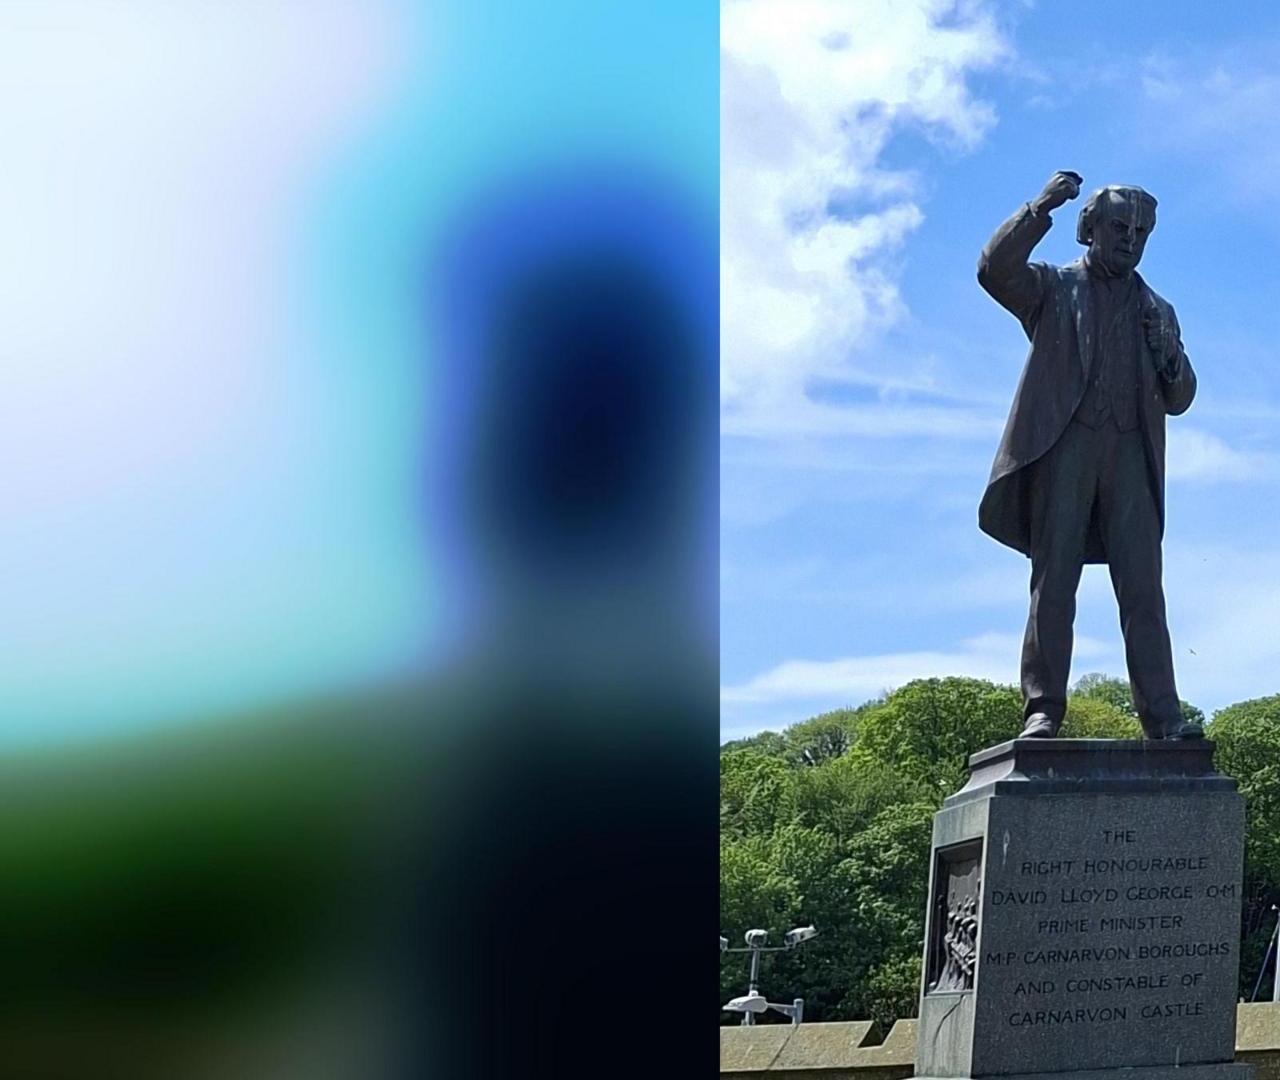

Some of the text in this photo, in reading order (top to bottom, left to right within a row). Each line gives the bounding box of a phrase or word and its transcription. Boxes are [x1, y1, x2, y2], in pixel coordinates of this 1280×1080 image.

[1103, 830, 1137, 844] THE
[1021, 856, 1209, 876] RIGHT HONOURABLE
[991, 889, 1048, 906] DAVID
[1060, 887, 1119, 904] LLOYD
[1125, 885, 1194, 901] GEORGE
[1038, 914, 1184, 934] PRIME MINISTER
[1023, 946, 1131, 965] CARNARVON
[1138, 941, 1231, 960] BOROUGHS
[1013, 972, 1205, 996] AND CONSTABLE OF
[1008, 1002, 1205, 1027] CARNARVON CASTLE
